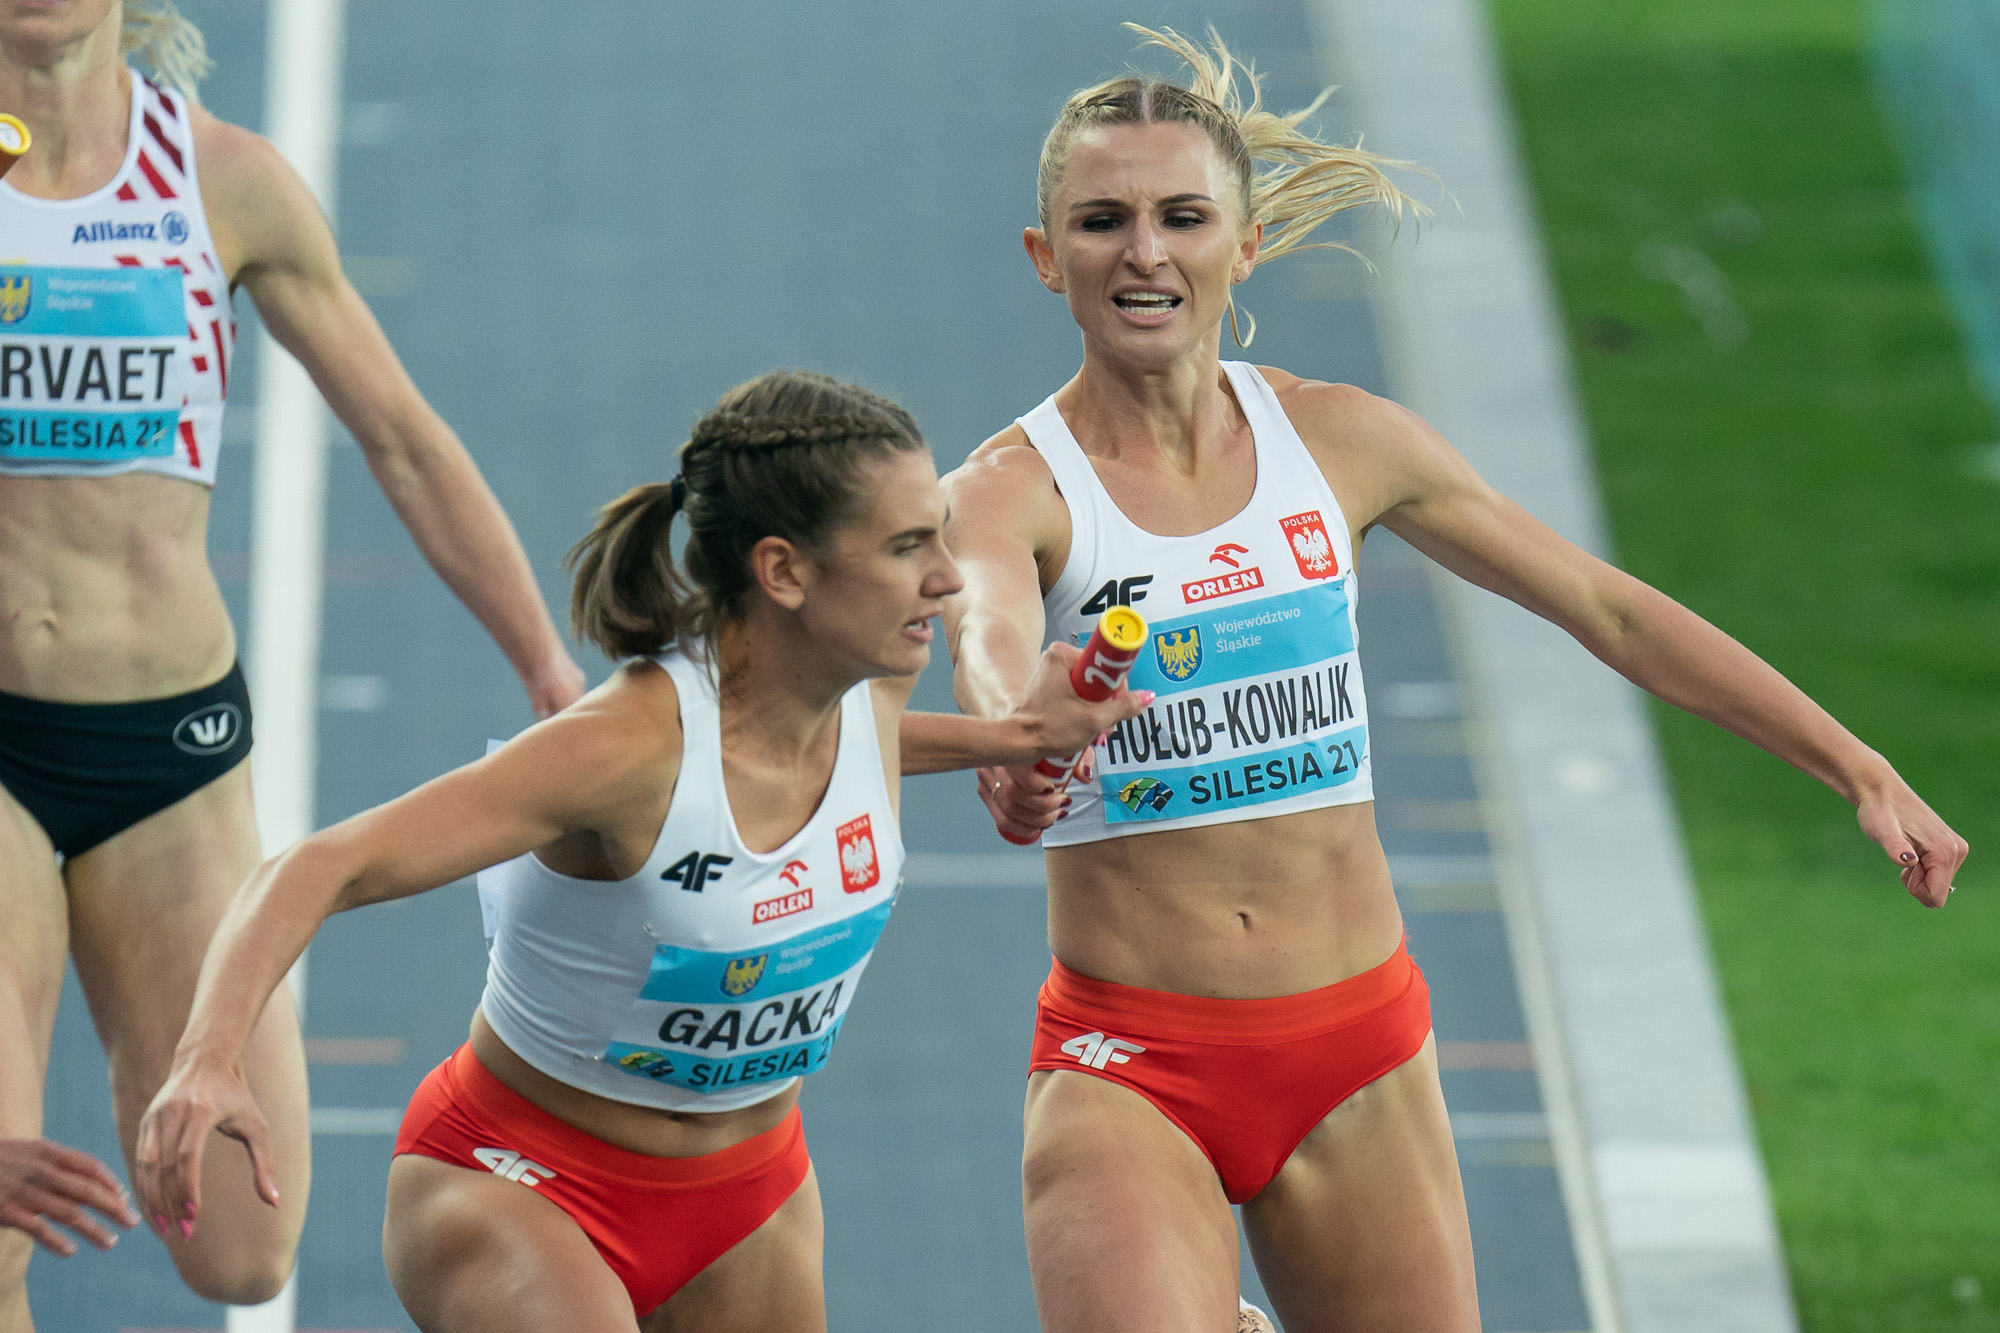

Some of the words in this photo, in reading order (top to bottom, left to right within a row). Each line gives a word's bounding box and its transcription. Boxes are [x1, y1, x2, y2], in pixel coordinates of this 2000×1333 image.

[72, 220, 157, 244] Allianz
[2, 344, 175, 401] RVAET
[0, 417, 126, 449] SILESIA
[1283, 513, 1320, 529] POLSKA
[1079, 574, 1154, 616] 4F
[1186, 570, 1259, 600] ORLEN
[1213, 608, 1301, 634] Województwo
[1216, 634, 1262, 653] Śląskie
[1084, 650, 1134, 691] 21
[1106, 661, 1354, 766] HOŁUB-KOWALIK
[1188, 752, 1323, 805] SILESIA
[1327, 739, 1359, 775] 21
[660, 850, 734, 893] 4F
[755, 891, 811, 921] ORLEN
[658, 979, 845, 1052] GACKA
[688, 1049, 809, 1087] SILESIA
[1060, 1031, 1147, 1071] 4F
[472, 1147, 557, 1187] 4F
